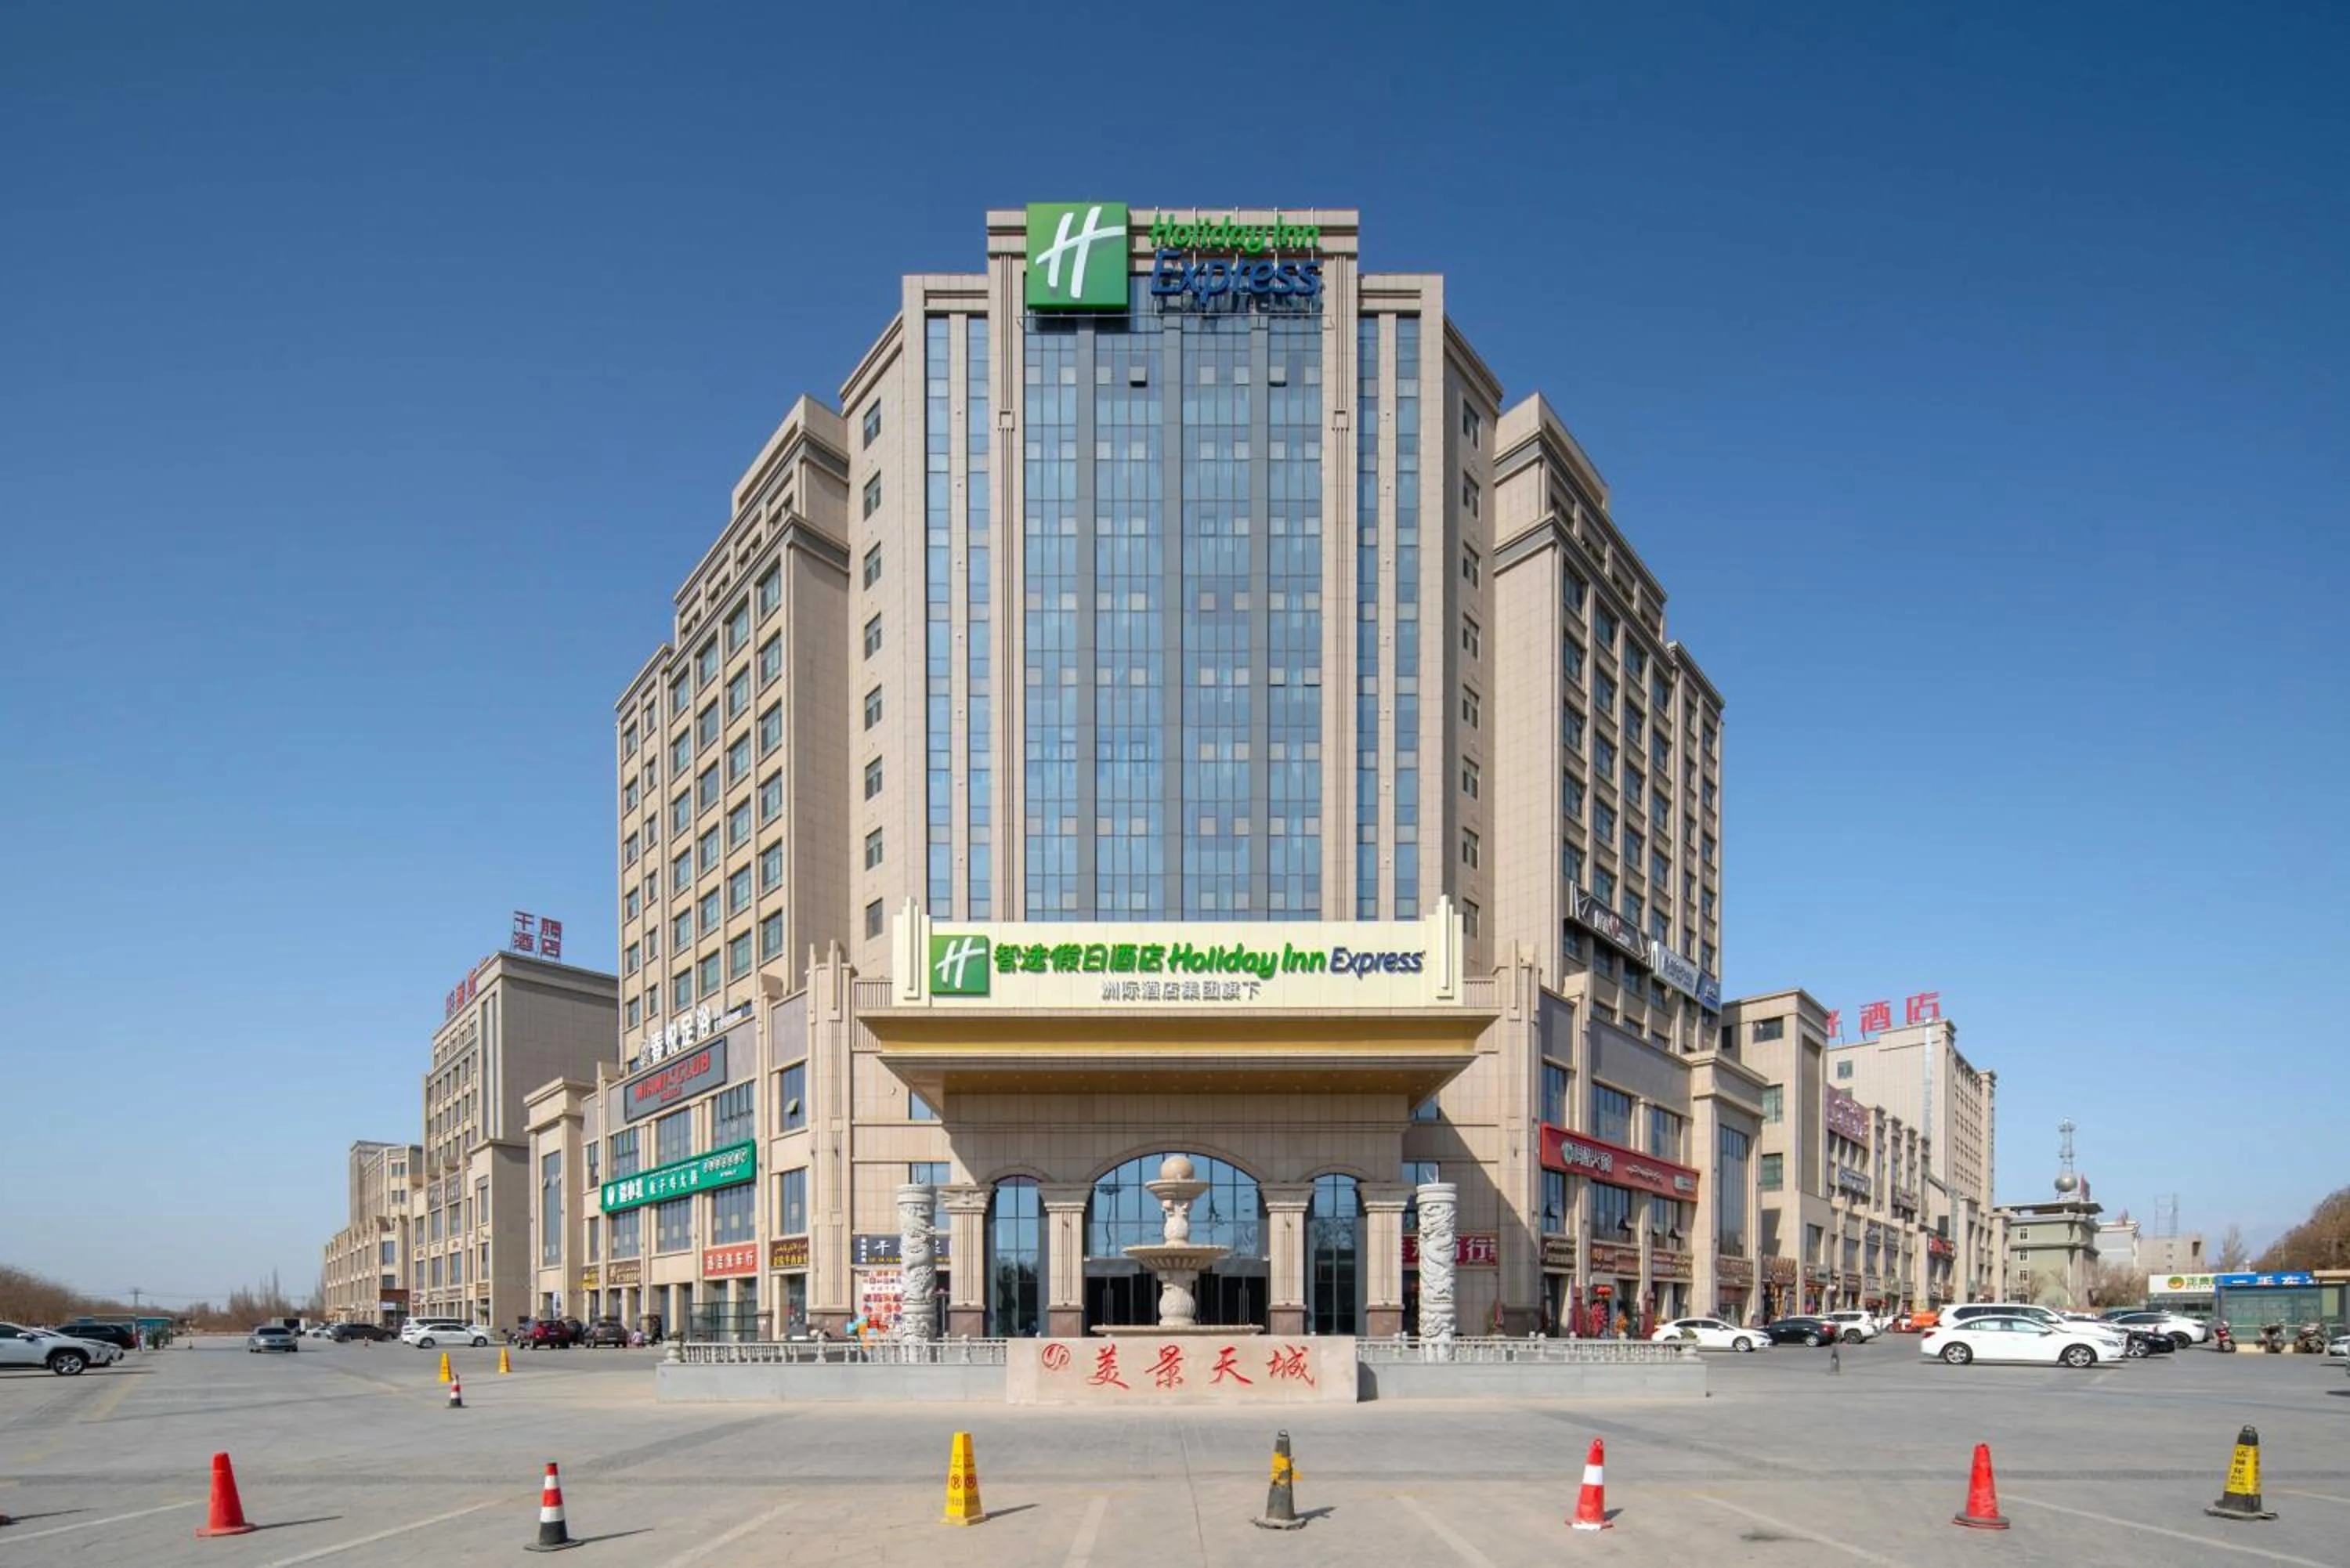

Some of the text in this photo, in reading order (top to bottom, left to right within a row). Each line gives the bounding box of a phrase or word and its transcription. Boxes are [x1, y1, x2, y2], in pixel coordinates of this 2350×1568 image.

[1149, 214, 1320, 253] Holiday Inn
[1150, 249, 1322, 306] Express
[994, 942, 1426, 979] 智选假日酒店 Holiday Inn Express
[1102, 981, 1261, 1002] 洲际酒店集团旗下
[1087, 1342, 1316, 1391] 美景天城
